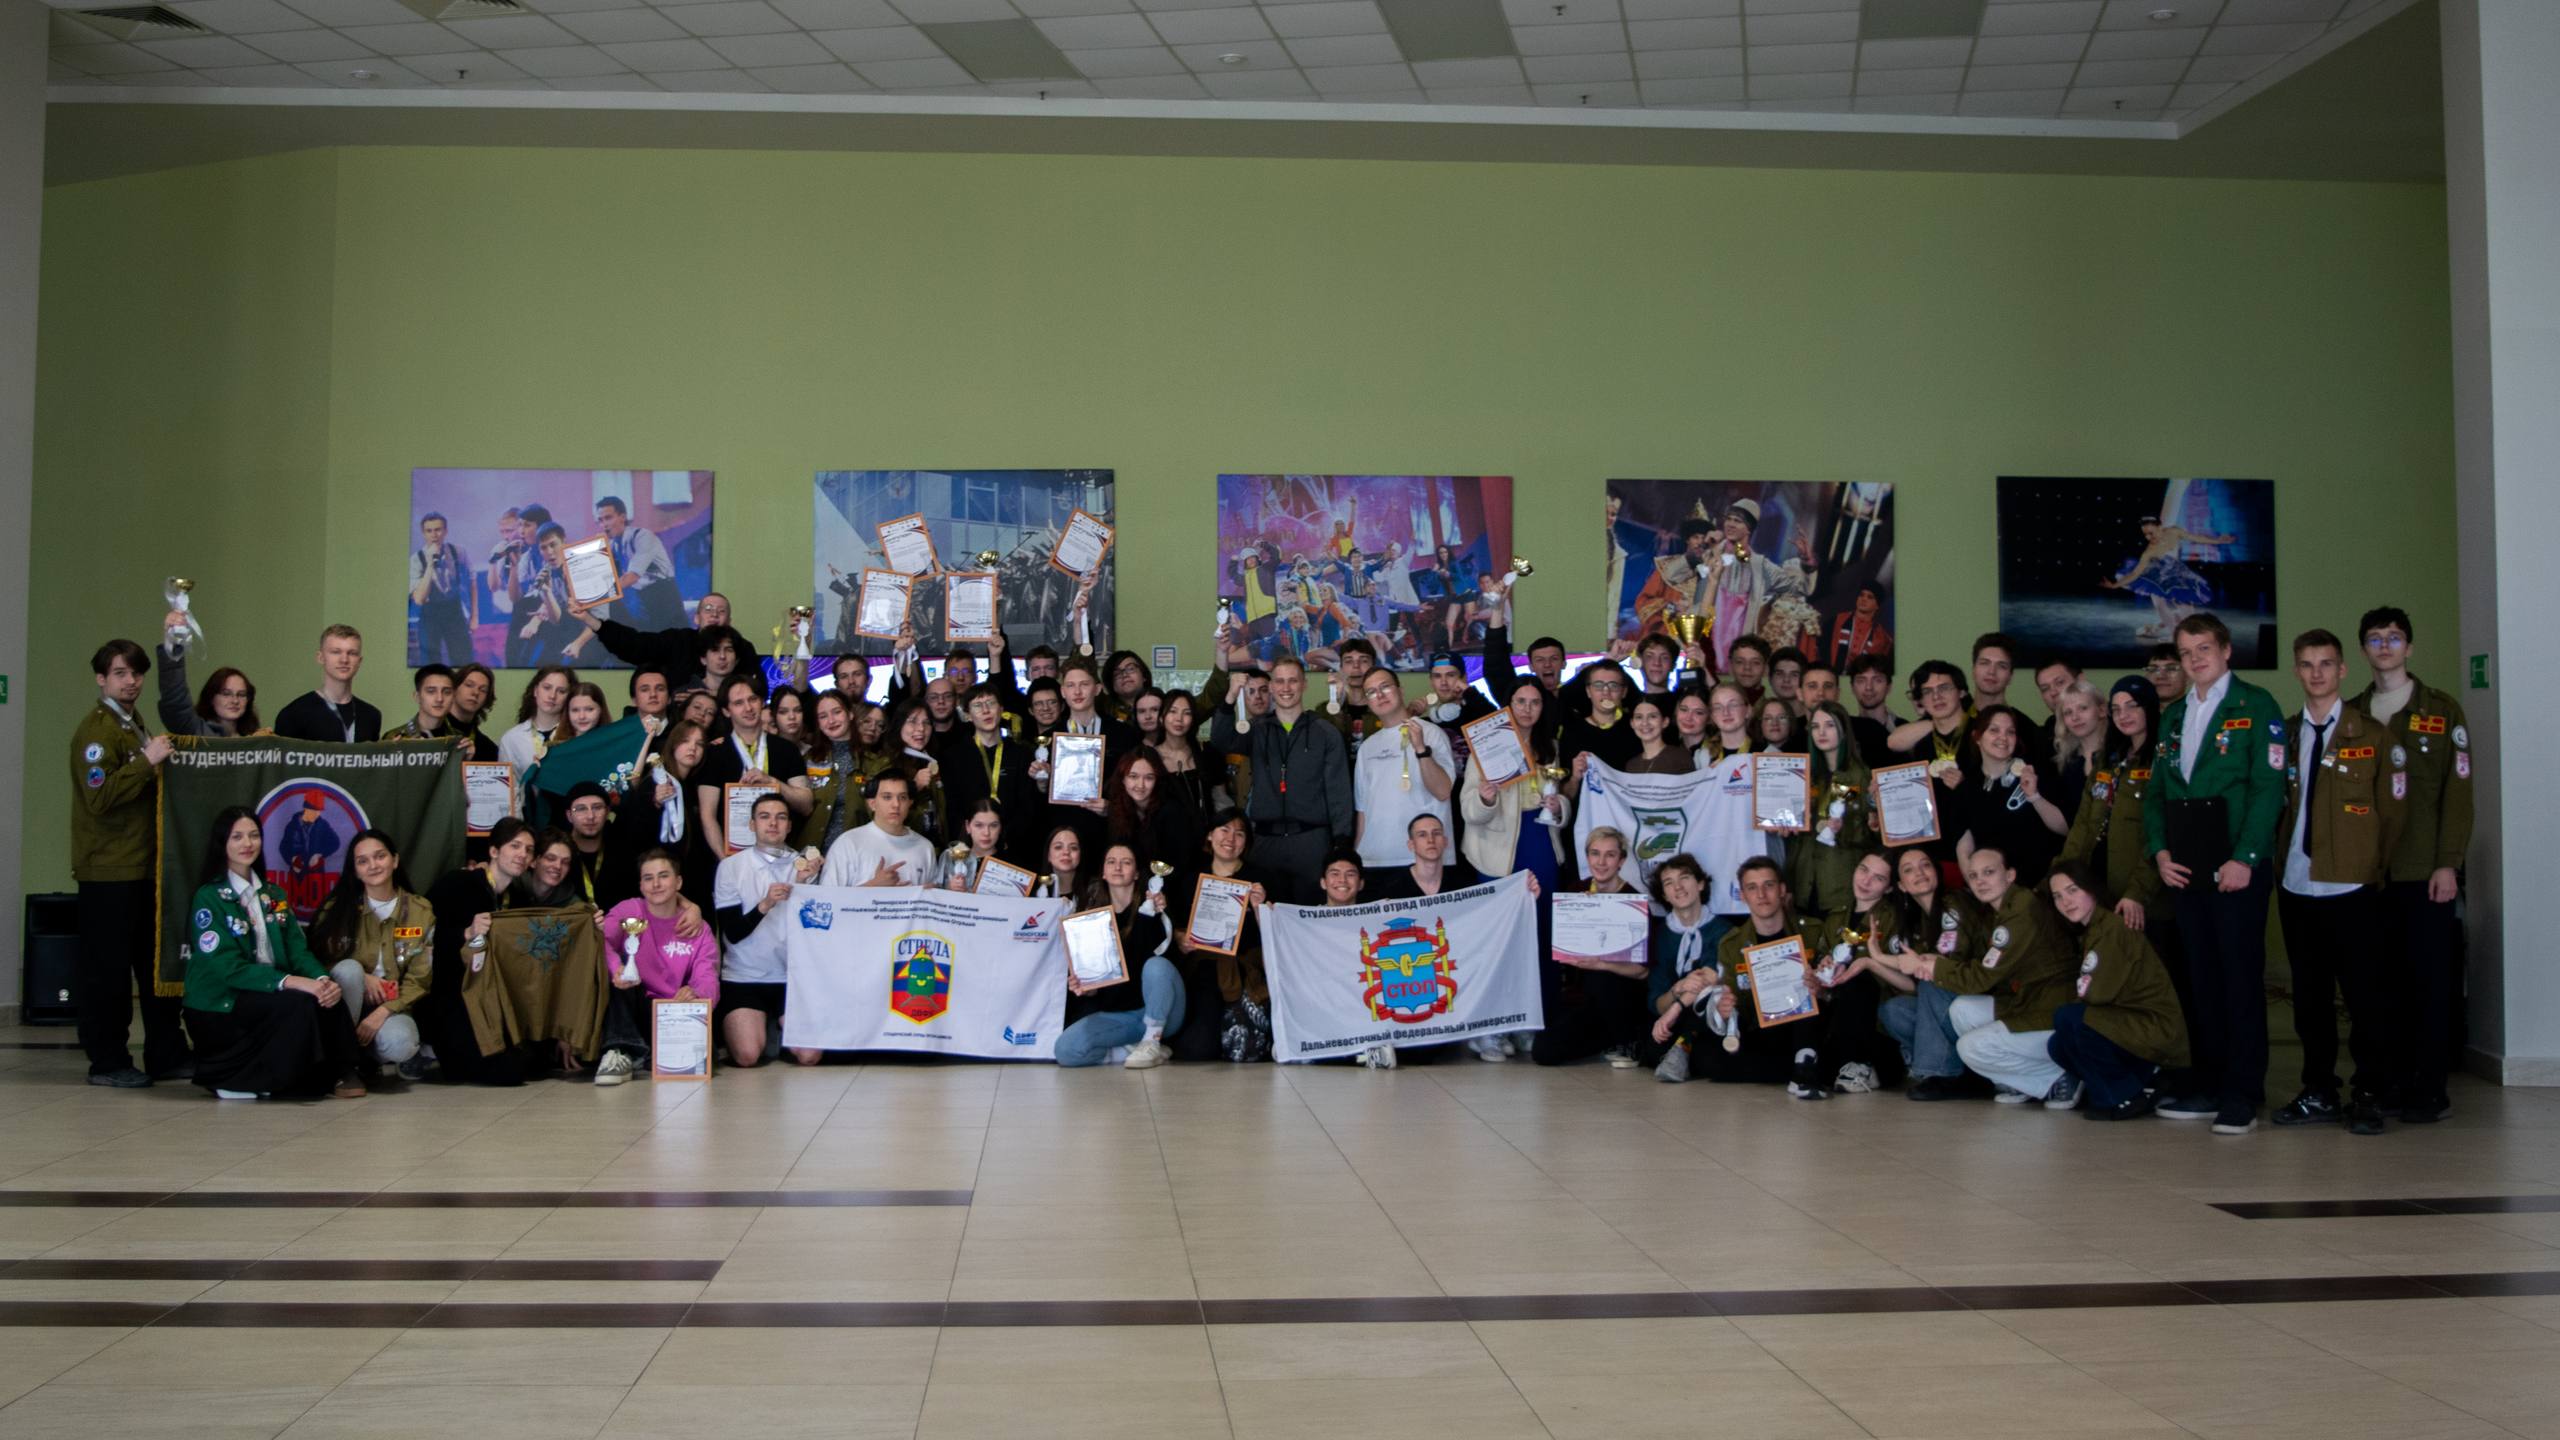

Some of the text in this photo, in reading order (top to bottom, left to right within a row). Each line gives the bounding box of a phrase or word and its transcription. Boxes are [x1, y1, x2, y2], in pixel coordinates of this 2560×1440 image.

[169, 747, 281, 768] СТУДЕНЧЕСКИЙ
[285, 750, 403, 768] СТРОИТЕЛЬНЫЙ
[1299, 886, 1496, 919] Студенческий отряд проводников
[898, 938, 950, 959] СТРЕЛА
[1386, 979, 1436, 999] СТОП
[1301, 1029, 1392, 1052] Дальневосточный
[1467, 1013, 1527, 1031] университет
